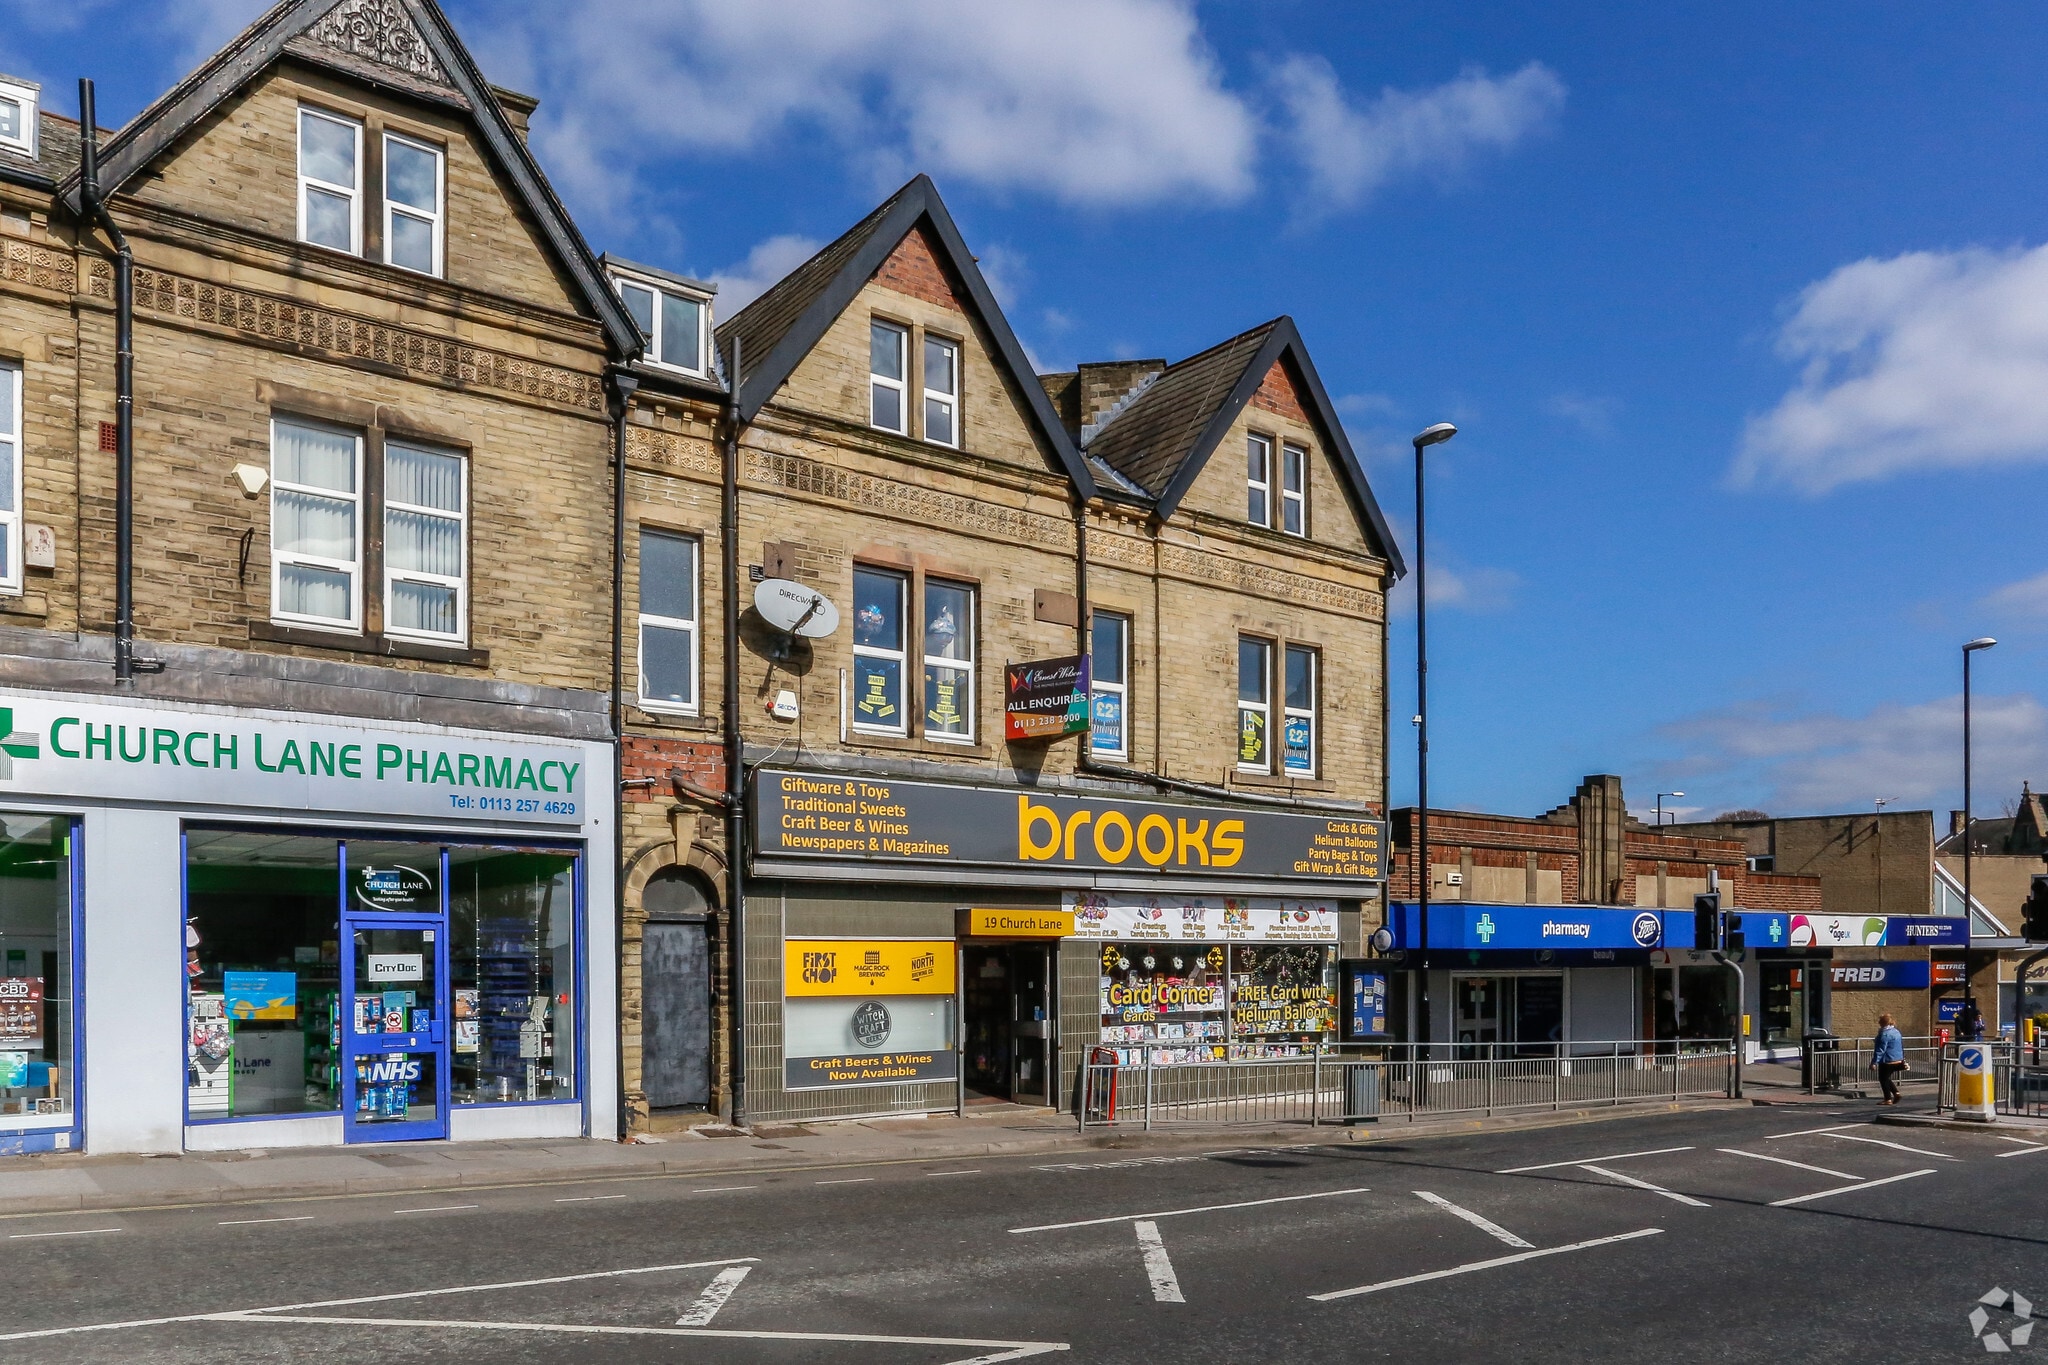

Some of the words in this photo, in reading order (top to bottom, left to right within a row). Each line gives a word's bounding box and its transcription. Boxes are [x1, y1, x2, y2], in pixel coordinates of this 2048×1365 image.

[779, 588, 813, 606] DIRECWA
[1007, 701, 1027, 712] ALL
[1029, 693, 1087, 709] ENQUIRIES
[1014, 718, 1036, 729] 0113
[1039, 716, 1055, 726] 238
[1058, 713, 1080, 724] 2900
[50, 716, 239, 770] CHURCH
[254, 733, 362, 779] LANE
[377, 743, 580, 793] PHARMACY
[781, 777, 842, 795] Giftware
[845, 782, 856, 796] &
[859, 783, 890, 801] Toys
[449, 795, 475, 809] Tel:
[479, 796, 512, 811] 0113
[516, 799, 540, 812] 257
[544, 801, 575, 815] 4629
[781, 795, 856, 814] Traditional
[859, 801, 906, 817] Sweets
[781, 814, 816, 830] Craft
[820, 816, 851, 832] Beer
[854, 818, 865, 833] &
[868, 819, 909, 835] Wines
[1018, 795, 1244, 867] brooks
[1327, 821, 1350, 833] Cards
[1351, 823, 1358, 834] &
[1359, 824, 1377, 835] Gifts
[781, 832, 865, 852] Newspapers
[868, 837, 879, 851] &
[883, 838, 949, 855] Magazines
[1314, 834, 1343, 847] Helium
[1344, 836, 1378, 849] Balloons
[1308, 847, 1330, 862] Party
[1331, 849, 1350, 862] Bags
[1351, 850, 1358, 861] &
[1360, 851, 1378, 864] Toys
[1294, 860, 1310, 873] Gift
[1311, 862, 1334, 875] Wrap
[1335, 863, 1342, 874] &
[1343, 864, 1358, 875] Gift
[1360, 865, 1378, 878] Bags
[364, 881, 400, 889] CHURCH
[380, 889, 408, 897] Pharmacy
[984, 917, 997, 928] 19
[1000, 918, 1036, 929] Church
[1039, 919, 1062, 930] Lane
[1543, 920, 1590, 938] pharmacy
[1905, 925, 1939, 937] HUNTERS
[1594, 950, 1615, 960] beauty
[911, 956, 934, 970] NORTH
[911, 970, 928, 979] BREWING
[1831, 967, 1886, 982] FRED
[0, 985, 29, 994] CBD
[1110, 983, 1152, 1005] Card
[1158, 983, 1216, 1004] Corner
[1237, 985, 1267, 1001] FREE
[1271, 984, 1299, 1000] Card
[1302, 983, 1328, 999] with
[856, 1010, 885, 1025] WITCH
[1123, 1010, 1156, 1022] Cards
[1236, 1006, 1281, 1023] Helium
[1284, 1005, 1329, 1020] Balloon
[858, 1020, 885, 1035] CRAFT
[865, 1034, 883, 1044] BEERS
[243, 1058, 271, 1068] Lane
[810, 1058, 842, 1069] Craft
[845, 1057, 879, 1067] Beers
[882, 1055, 893, 1065] &
[895, 1054, 932, 1064] Wines
[372, 1061, 420, 1081] NHS
[829, 1071, 858, 1081] Now
[861, 1067, 917, 1078] Available
